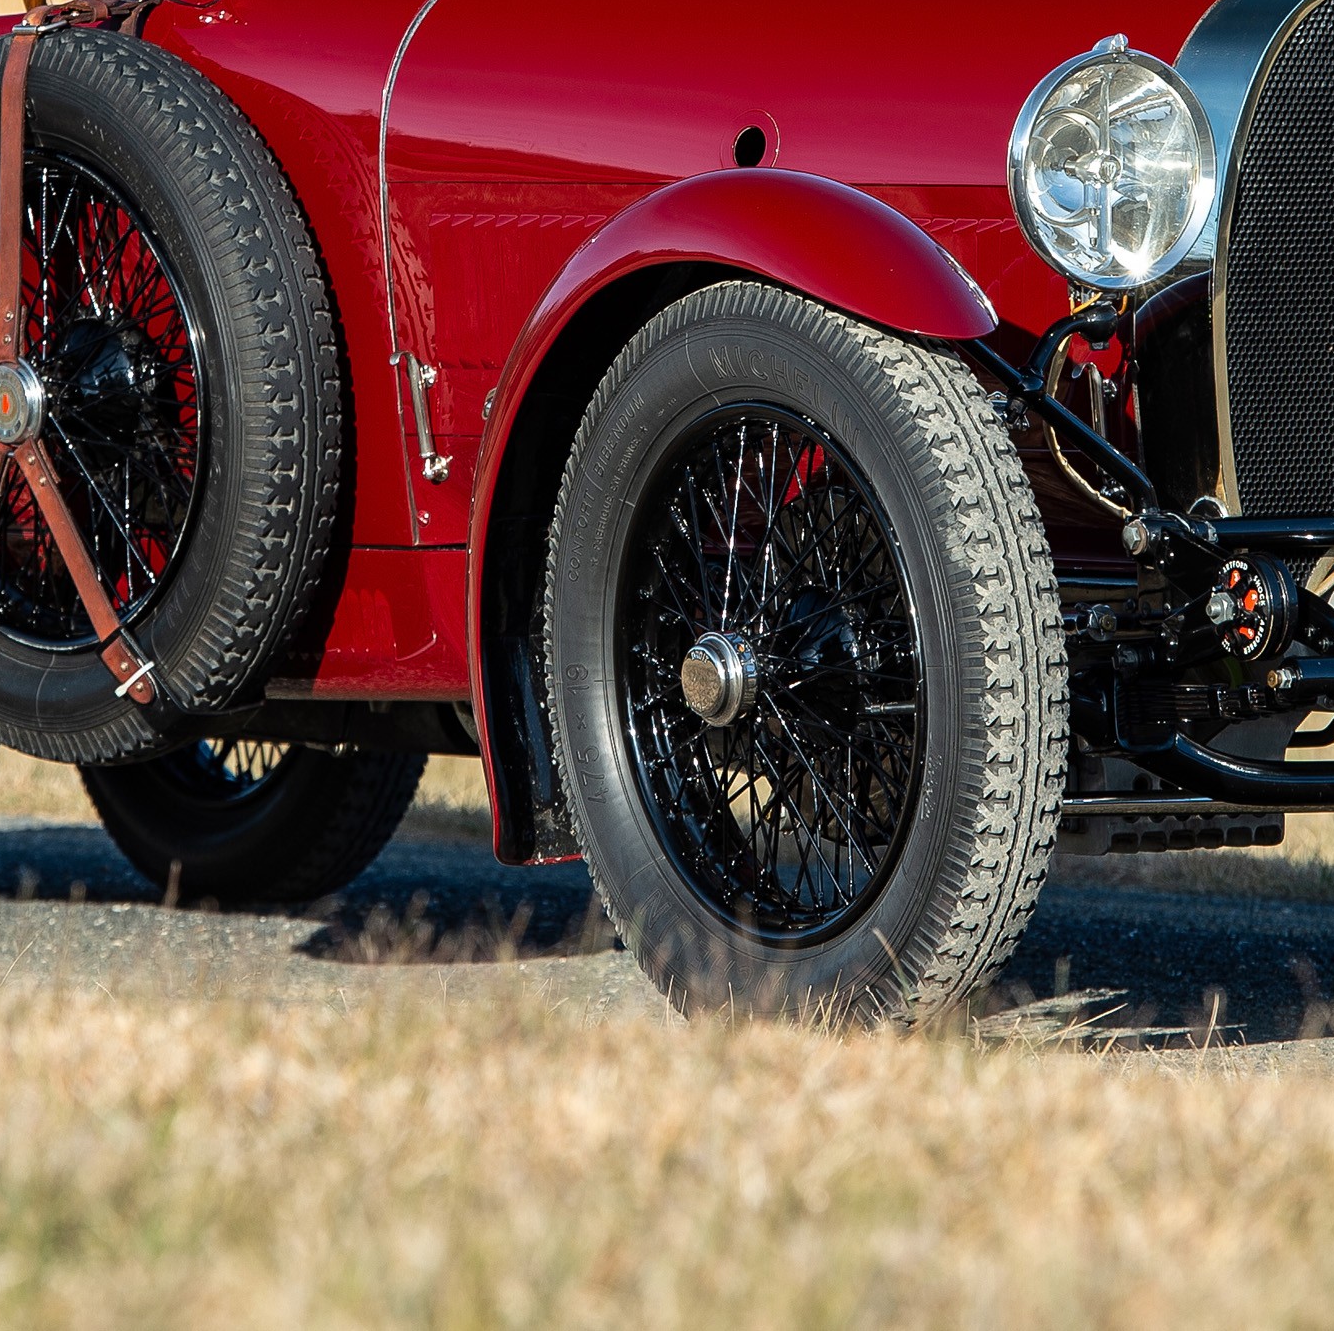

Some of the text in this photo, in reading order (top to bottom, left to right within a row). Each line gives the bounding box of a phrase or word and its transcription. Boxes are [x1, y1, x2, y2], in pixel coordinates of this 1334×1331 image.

[708, 344, 861, 455] MICHELIN
[617, 435, 642, 474] FRANCE
[567, 390, 646, 582] CONFORT BIBENDUM
[1252, 575, 1266, 606] SHOCK
[565, 663, 590, 696] 19
